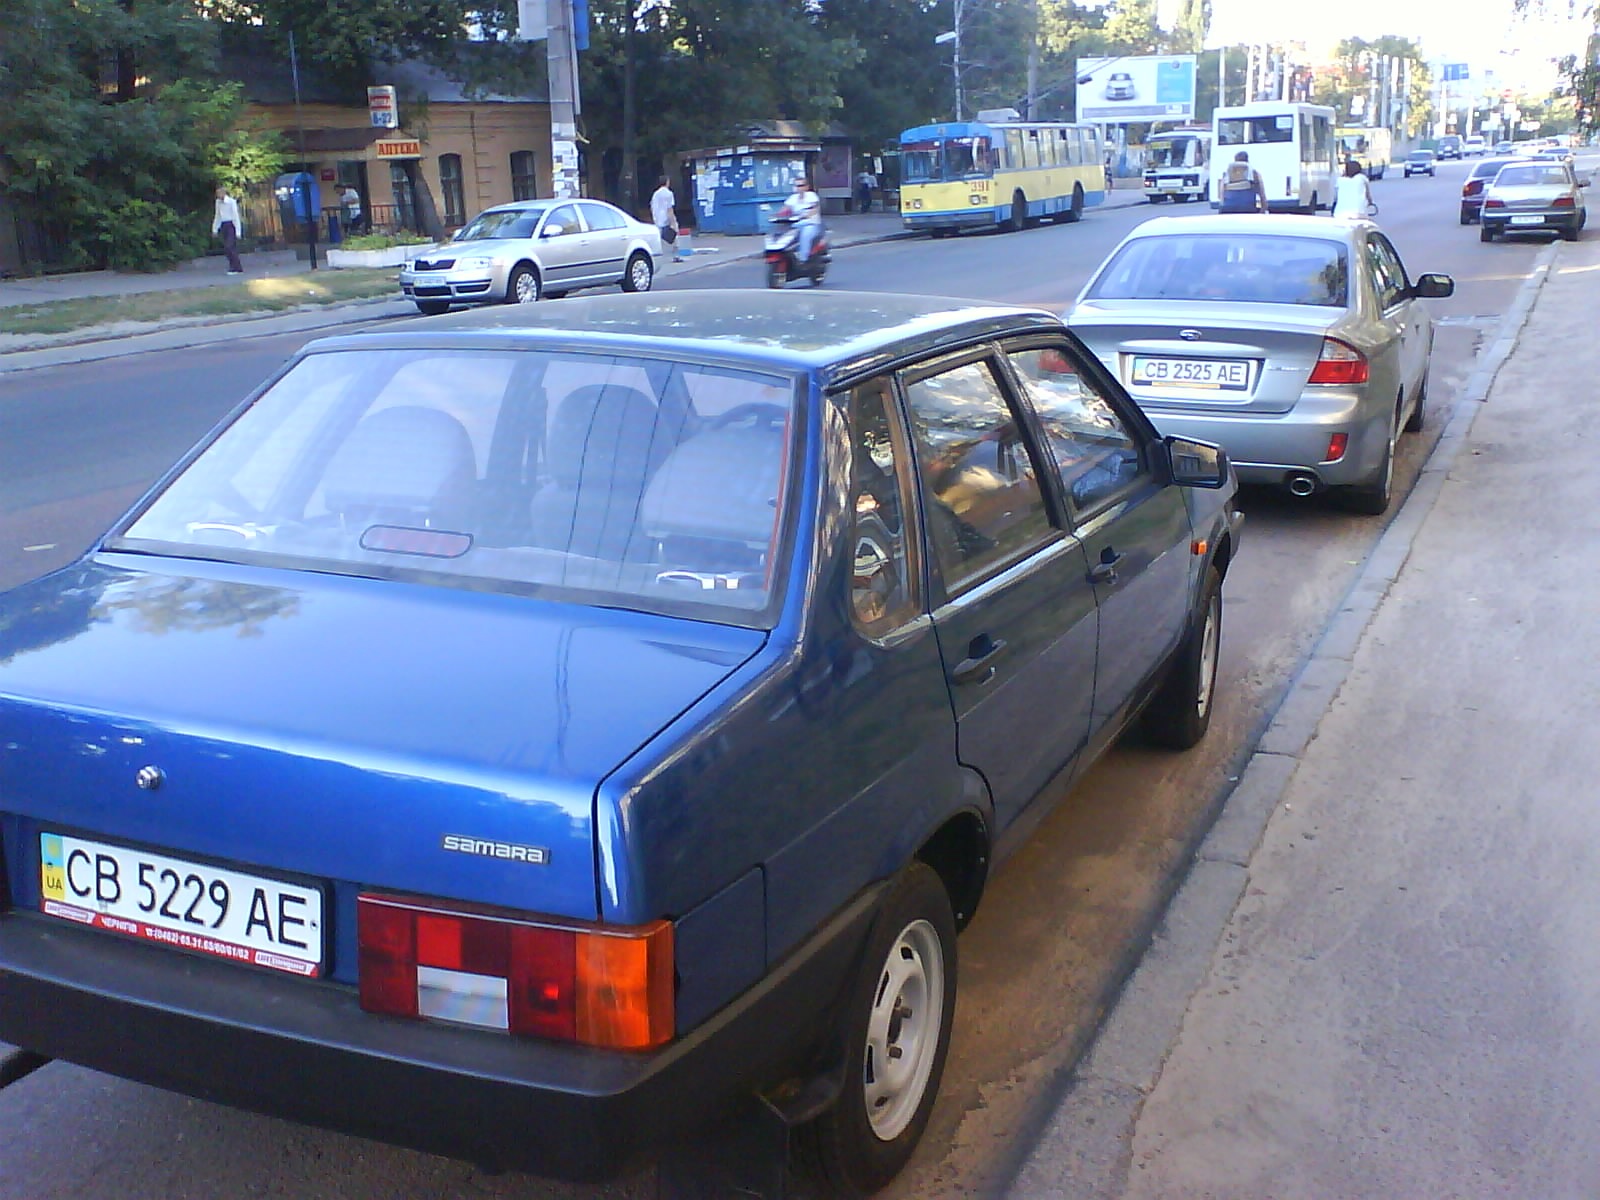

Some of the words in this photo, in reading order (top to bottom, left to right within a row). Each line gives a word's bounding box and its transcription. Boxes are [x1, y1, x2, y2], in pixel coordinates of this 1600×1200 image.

[378, 142, 419, 155] АПТЕКА
[1146, 362, 1168, 379] CB
[1173, 363, 1212, 380] 2525
[1217, 365, 1242, 382] AE
[46, 875, 63, 891] UA
[67, 849, 121, 903] CB
[138, 863, 230, 929] 5229
[246, 888, 308, 949] AE
